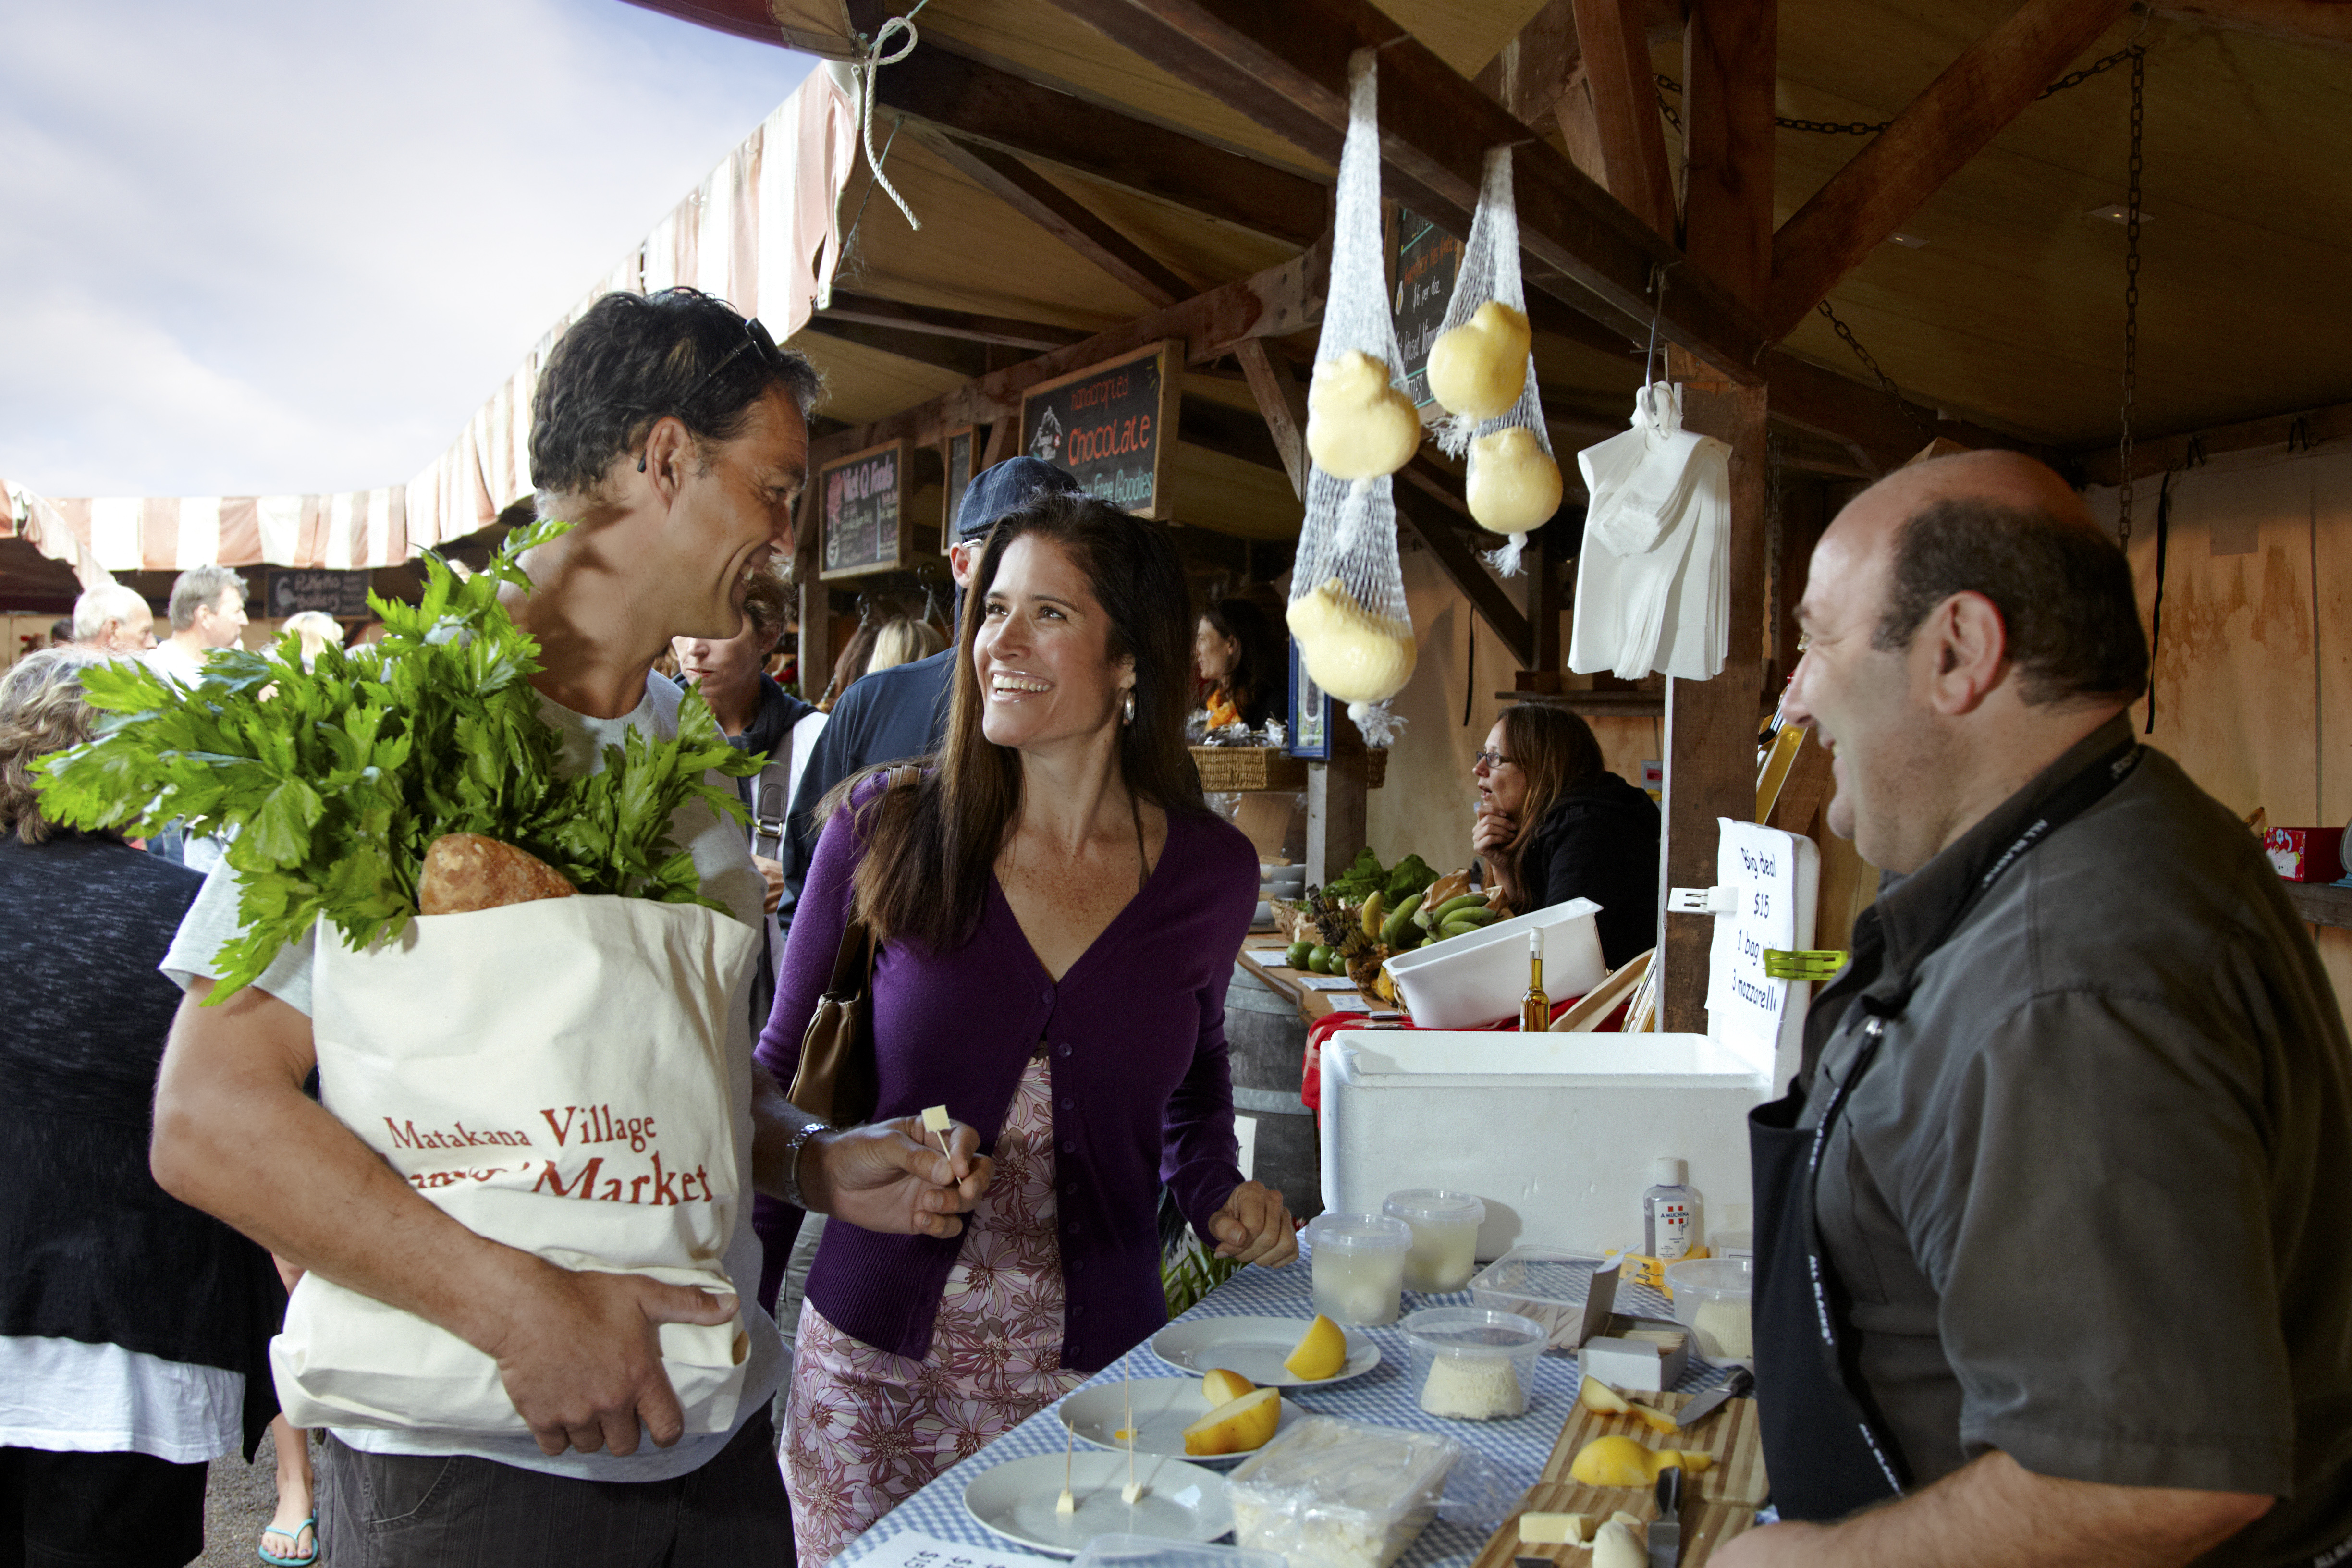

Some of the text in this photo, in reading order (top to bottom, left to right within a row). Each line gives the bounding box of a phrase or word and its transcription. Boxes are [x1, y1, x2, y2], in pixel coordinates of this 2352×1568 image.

[1421, 286, 1430, 306] per
[1068, 414, 1151, 466] Chocolate
[1115, 466, 1153, 503] Goodies
[1740, 847, 1776, 880] Big deal
[1753, 889, 1769, 919] $15
[1738, 928, 1742, 951] 1
[1744, 931, 1760, 967] bag
[1732, 968, 1737, 991] 3
[382, 1103, 657, 1153] Matakana Village
[530, 1149, 713, 1206] Market
